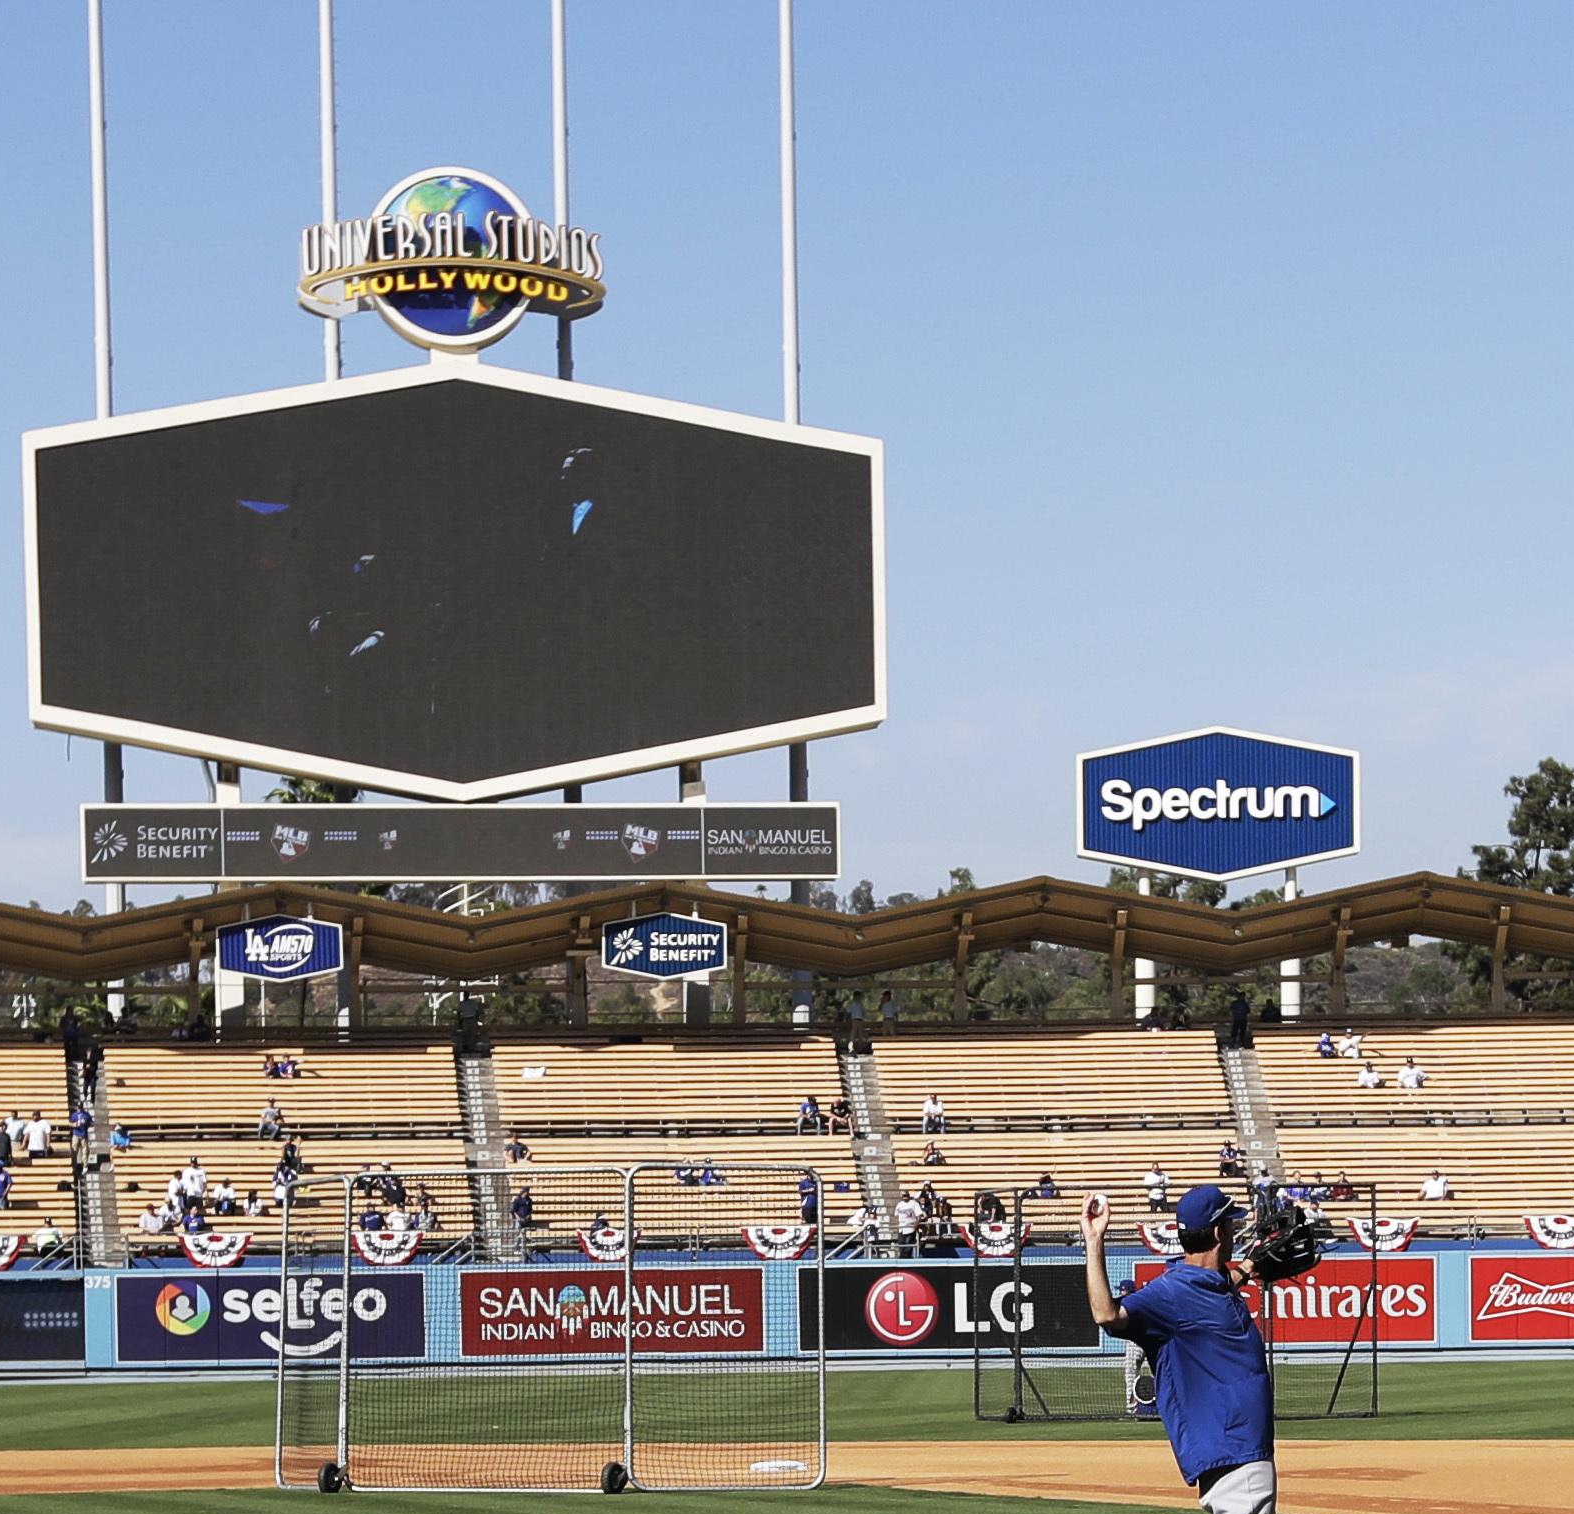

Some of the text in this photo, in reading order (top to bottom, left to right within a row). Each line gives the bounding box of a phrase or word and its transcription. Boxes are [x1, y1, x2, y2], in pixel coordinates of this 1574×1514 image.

[301, 210, 604, 281] UNIVERSAL STUDIOS
[343, 271, 570, 302] HOLLYWOOD
[1100, 778, 1320, 831] Spectrum
[136, 825, 219, 841] SECURITY
[274, 824, 309, 843] MLB
[624, 823, 660, 842] MLB
[706, 829, 832, 845] SAN MANUEL
[707, 846, 743, 856] INDIAN
[797, 846, 833, 856] CASINO
[245, 928, 314, 962] LA AM570
[650, 932, 721, 946] SECURITY
[84, 1276, 112, 1289] 375
[479, 1286, 554, 1319] SAN
[954, 1281, 1035, 1334] LG
[481, 1323, 555, 1341] INDIAN
[656, 1321, 671, 1338] &
[673, 1320, 745, 1338] CASINO
